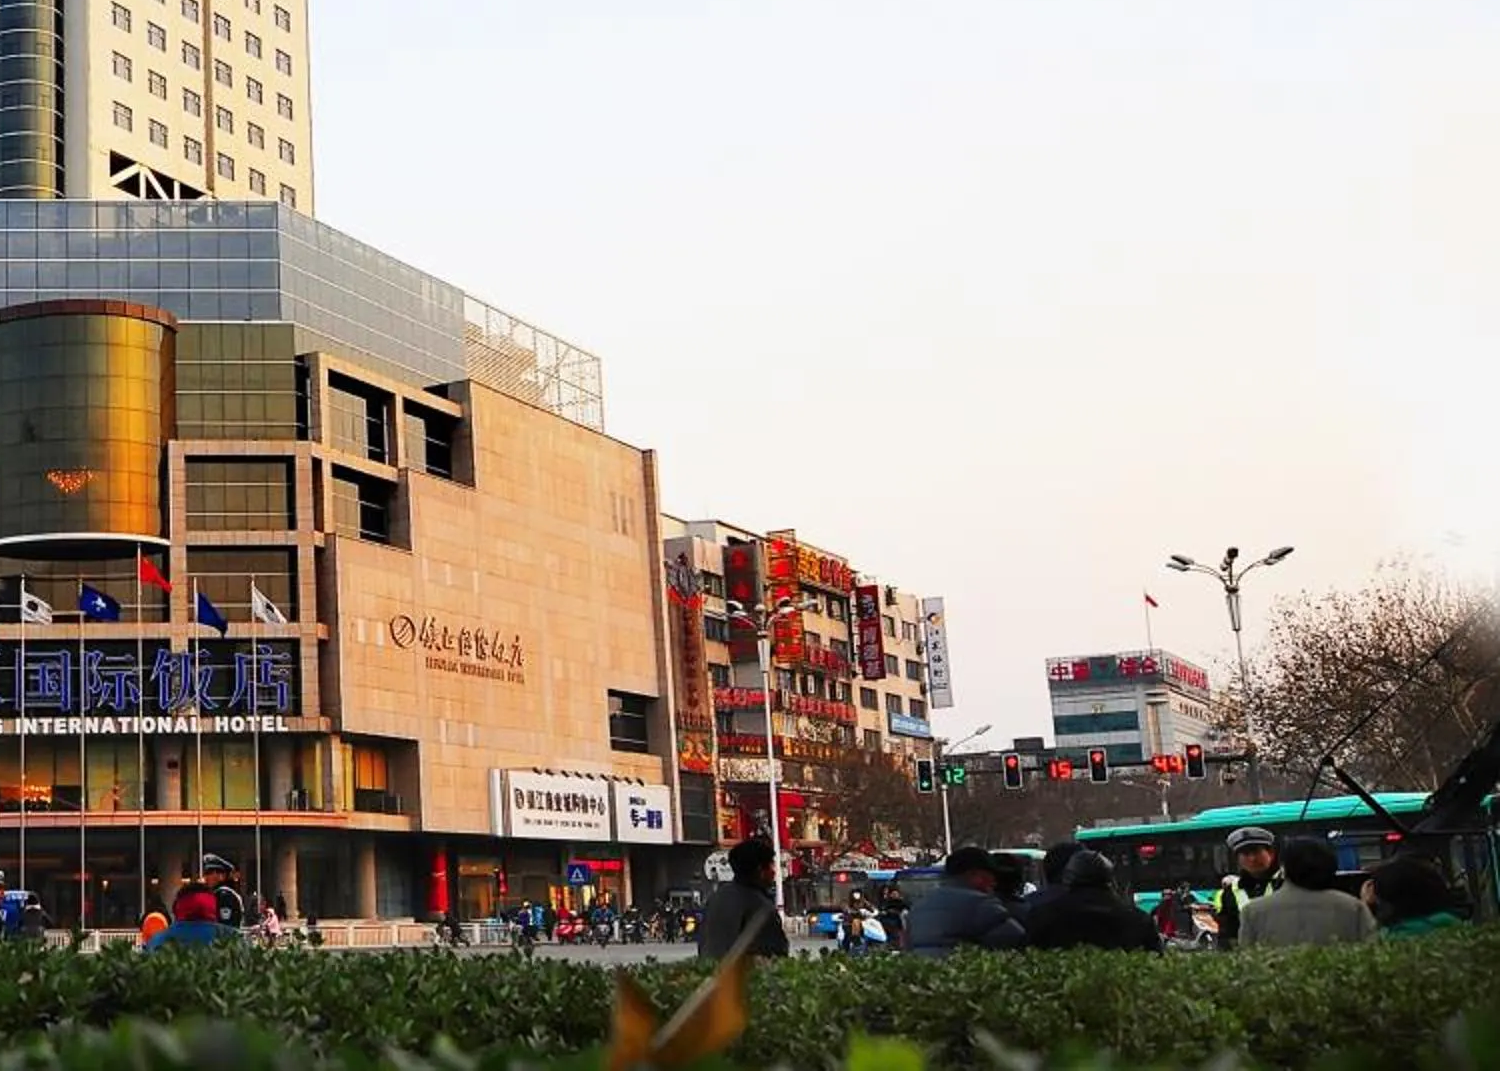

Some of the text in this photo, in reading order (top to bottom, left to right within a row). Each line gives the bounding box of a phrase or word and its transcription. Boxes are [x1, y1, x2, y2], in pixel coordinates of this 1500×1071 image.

[15, 716, 198, 735] INTERNATIONAL
[215, 716, 289, 733] HOTEL
[945, 767, 965, 784] 12
[1051, 761, 1072, 778] 15
